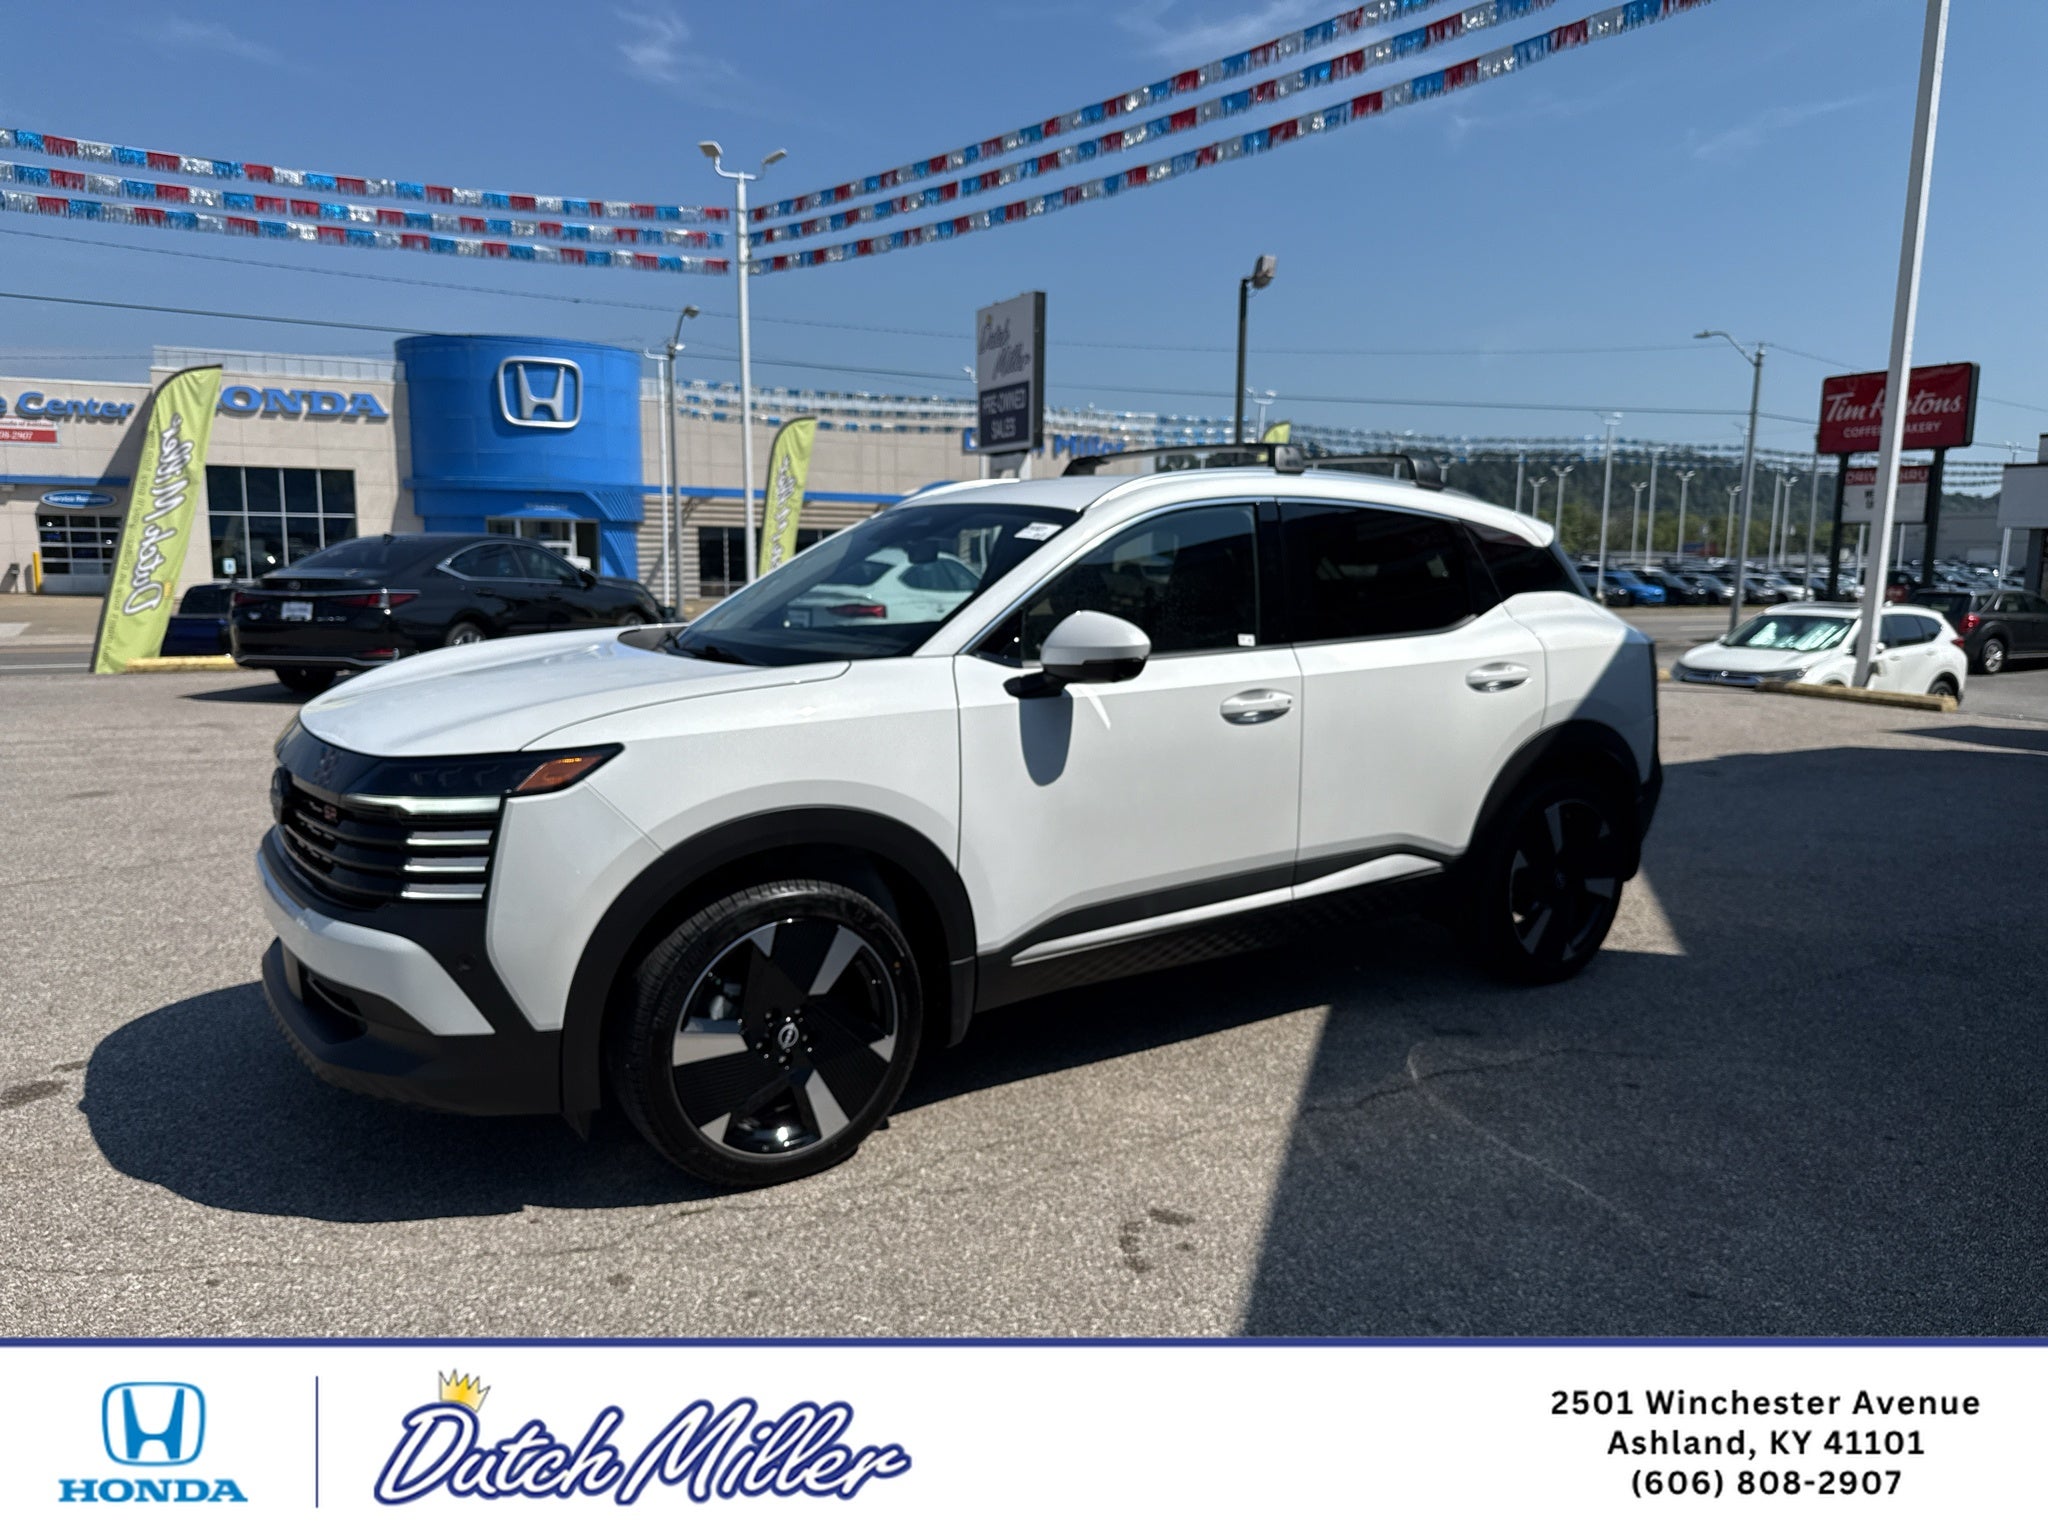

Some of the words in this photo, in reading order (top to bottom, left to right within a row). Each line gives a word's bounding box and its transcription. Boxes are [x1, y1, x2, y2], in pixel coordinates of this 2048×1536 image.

[18, 391, 136, 418] Center
[217, 386, 389, 418] ONDA
[1826, 391, 1867, 422] Tim
[991, 417, 1017, 440] SALES
[1843, 424, 1881, 438] COFFE
[1904, 420, 1942, 433] AKERY
[1845, 470, 1876, 484] DRIV
